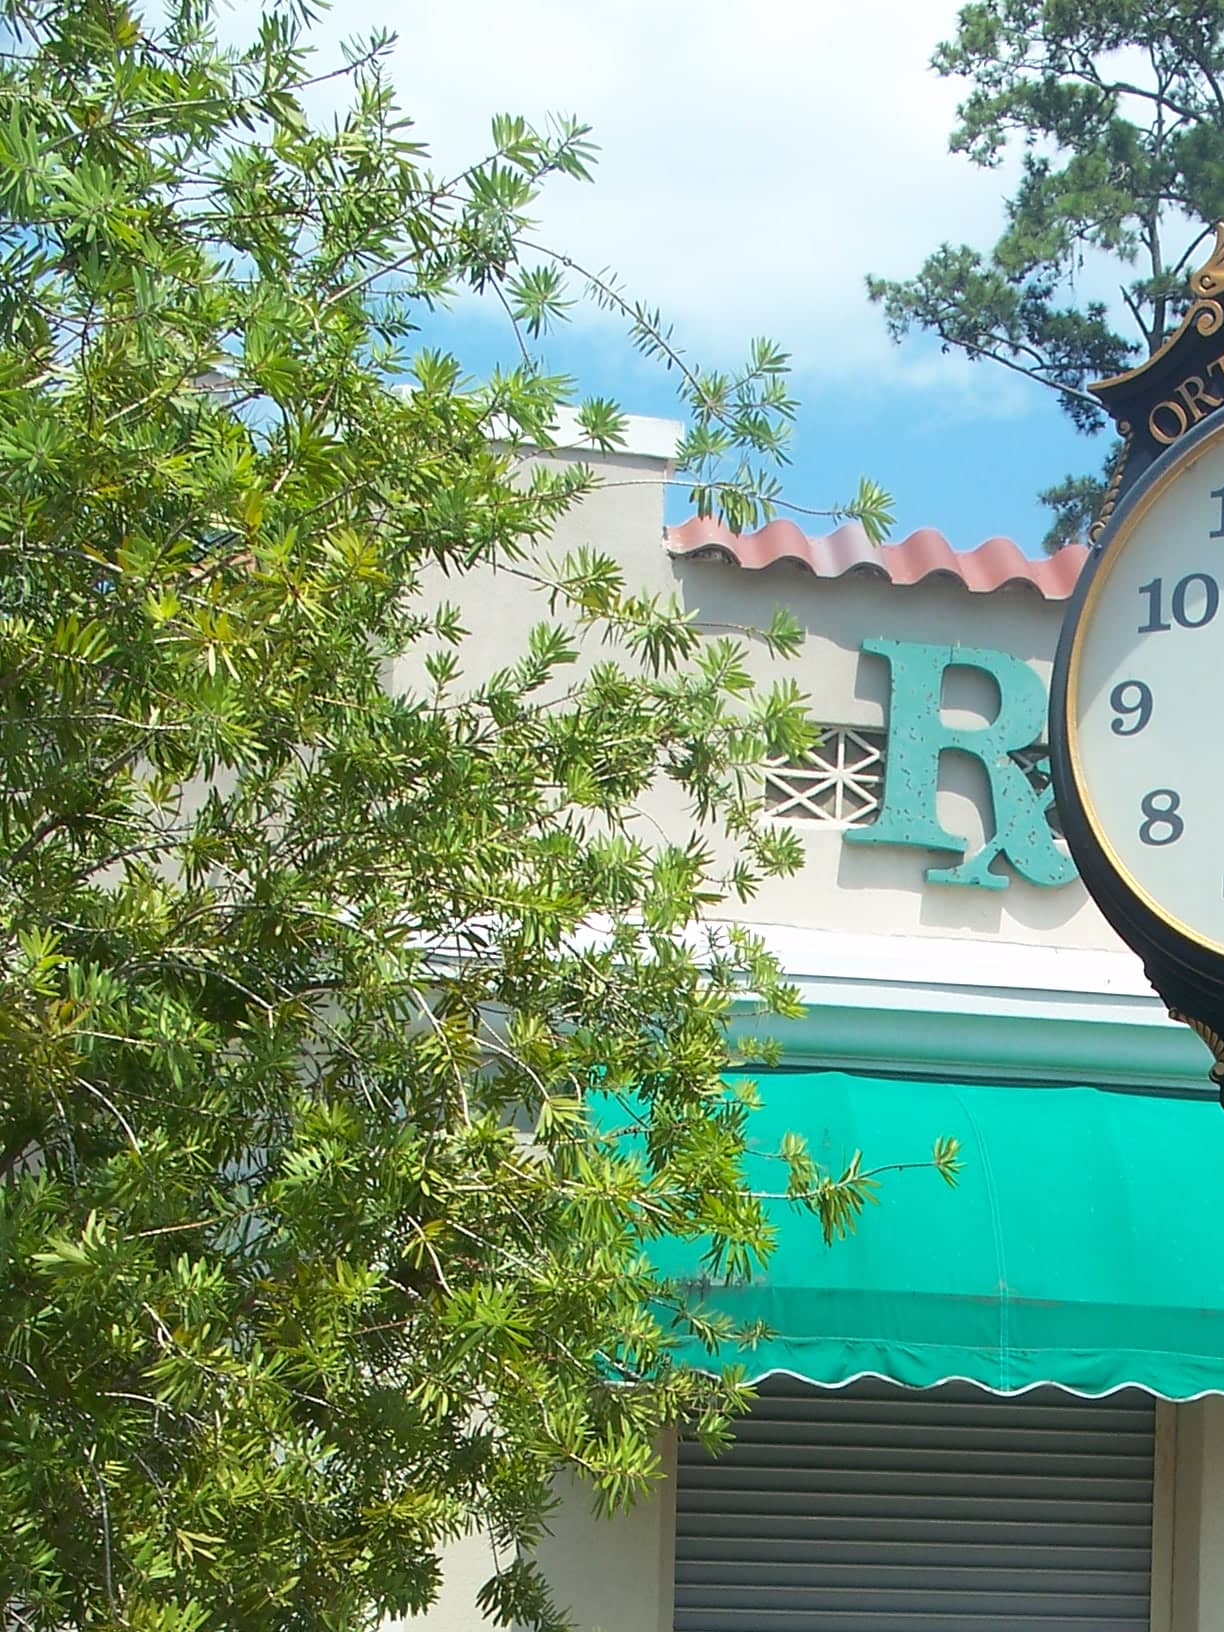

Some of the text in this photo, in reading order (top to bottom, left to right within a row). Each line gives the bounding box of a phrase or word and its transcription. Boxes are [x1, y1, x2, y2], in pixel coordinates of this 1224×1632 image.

[1137, 573, 1220, 634] 10
[1110, 680, 1153, 736] 9
[1139, 789, 1184, 846] 8
